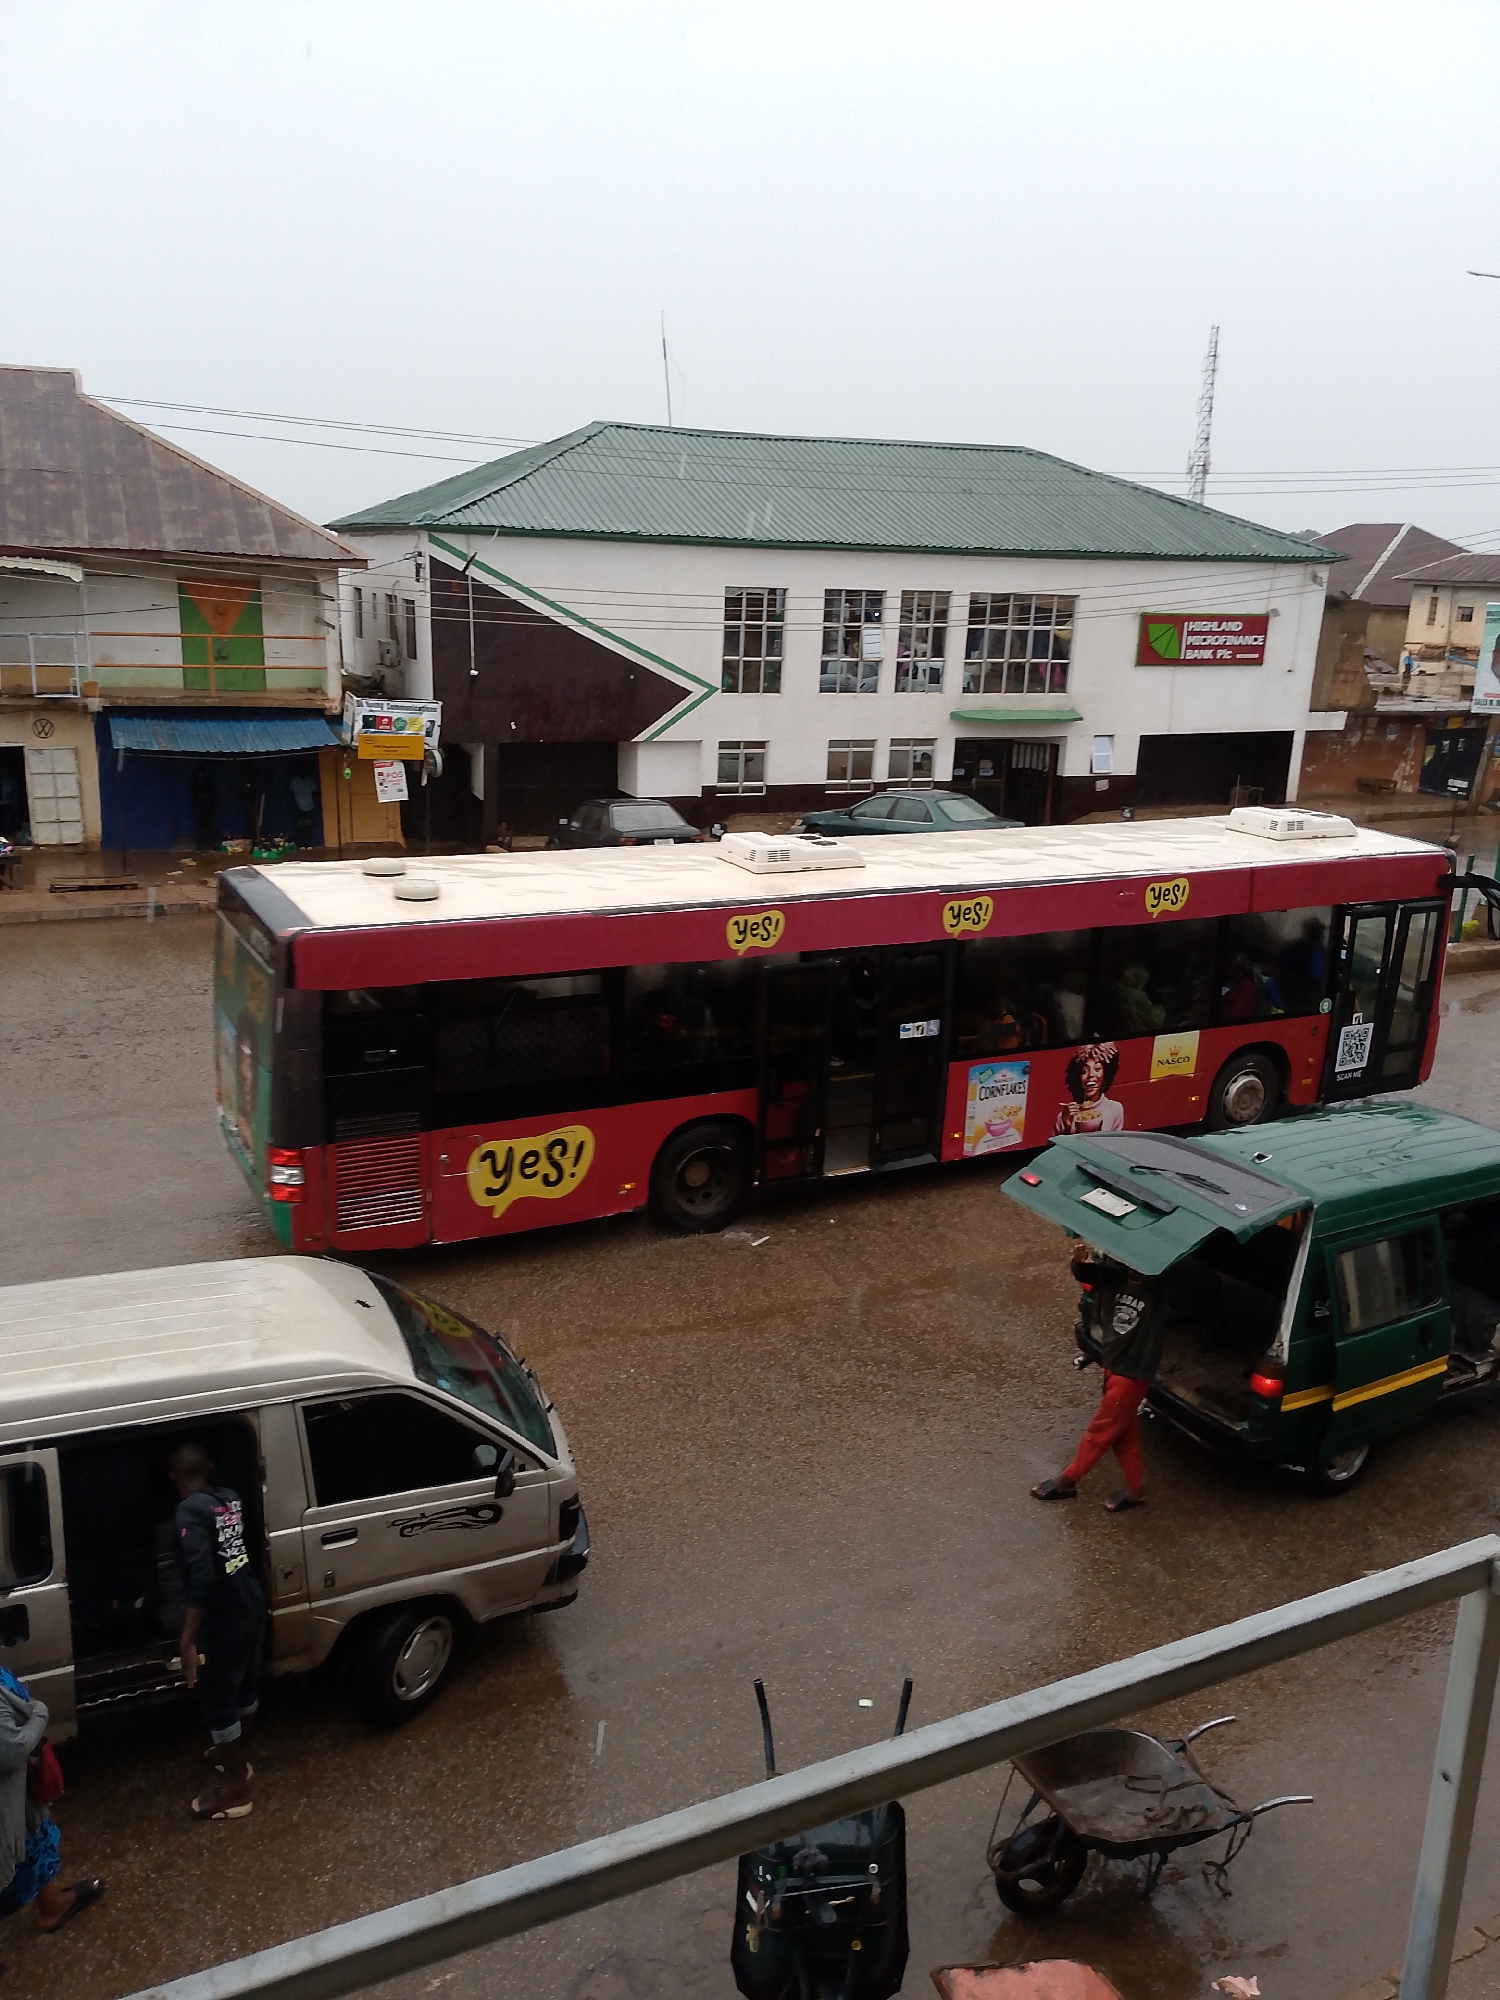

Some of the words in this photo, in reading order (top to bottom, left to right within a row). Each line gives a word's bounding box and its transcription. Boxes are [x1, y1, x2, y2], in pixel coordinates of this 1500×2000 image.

[1188, 621, 1243, 632] HIGHLAND
[1186, 635, 1265, 646] MICROFINANCE
[1185, 649, 1214, 660] BANK
[1156, 1056, 1190, 1067] NASCO
[1336, 1072, 1352, 1081] SCAN
[1353, 1070, 1363, 1078] ME
[979, 1080, 1026, 1101] CORNFLAKES
